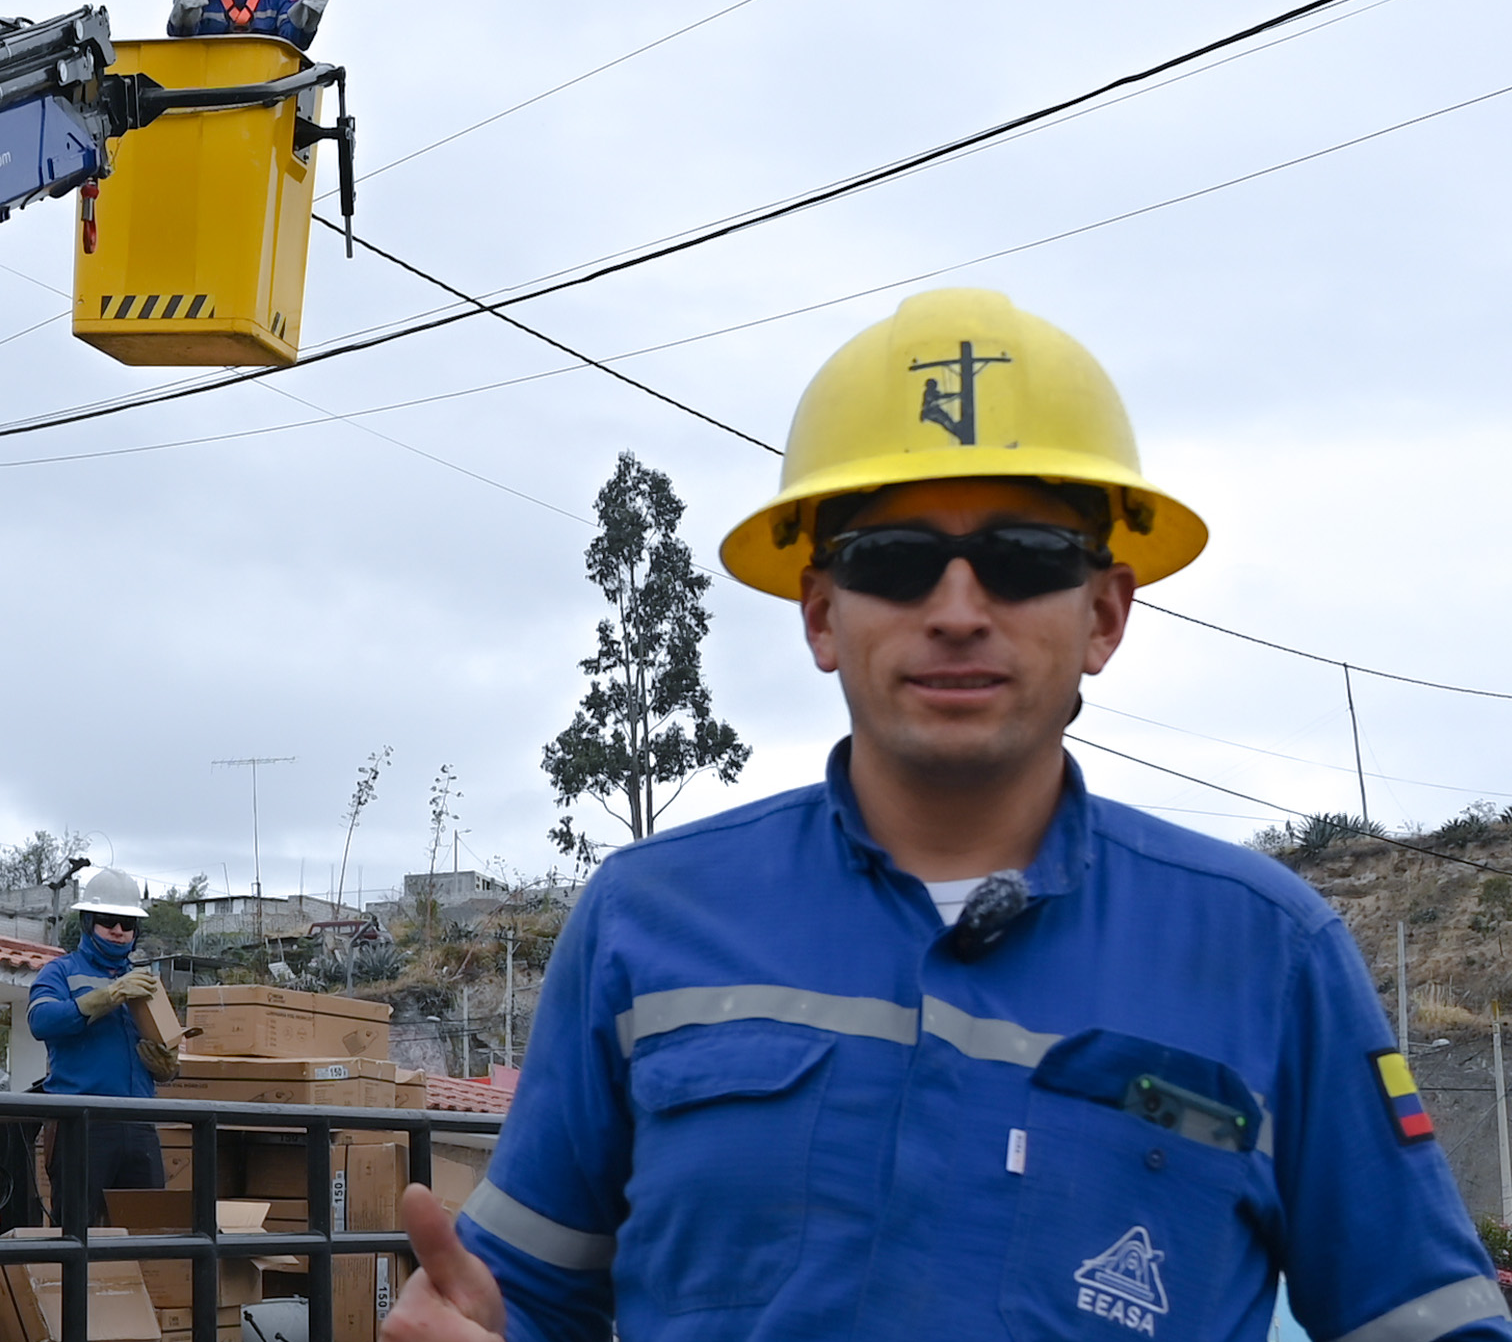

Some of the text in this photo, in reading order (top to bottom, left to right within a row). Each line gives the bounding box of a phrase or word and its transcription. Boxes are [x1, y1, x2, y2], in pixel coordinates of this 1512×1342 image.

[330, 1067, 343, 1077] 150
[334, 1182, 343, 1204] 150
[378, 1286, 387, 1308] 150
[1076, 1287, 1155, 1338] EEASA
